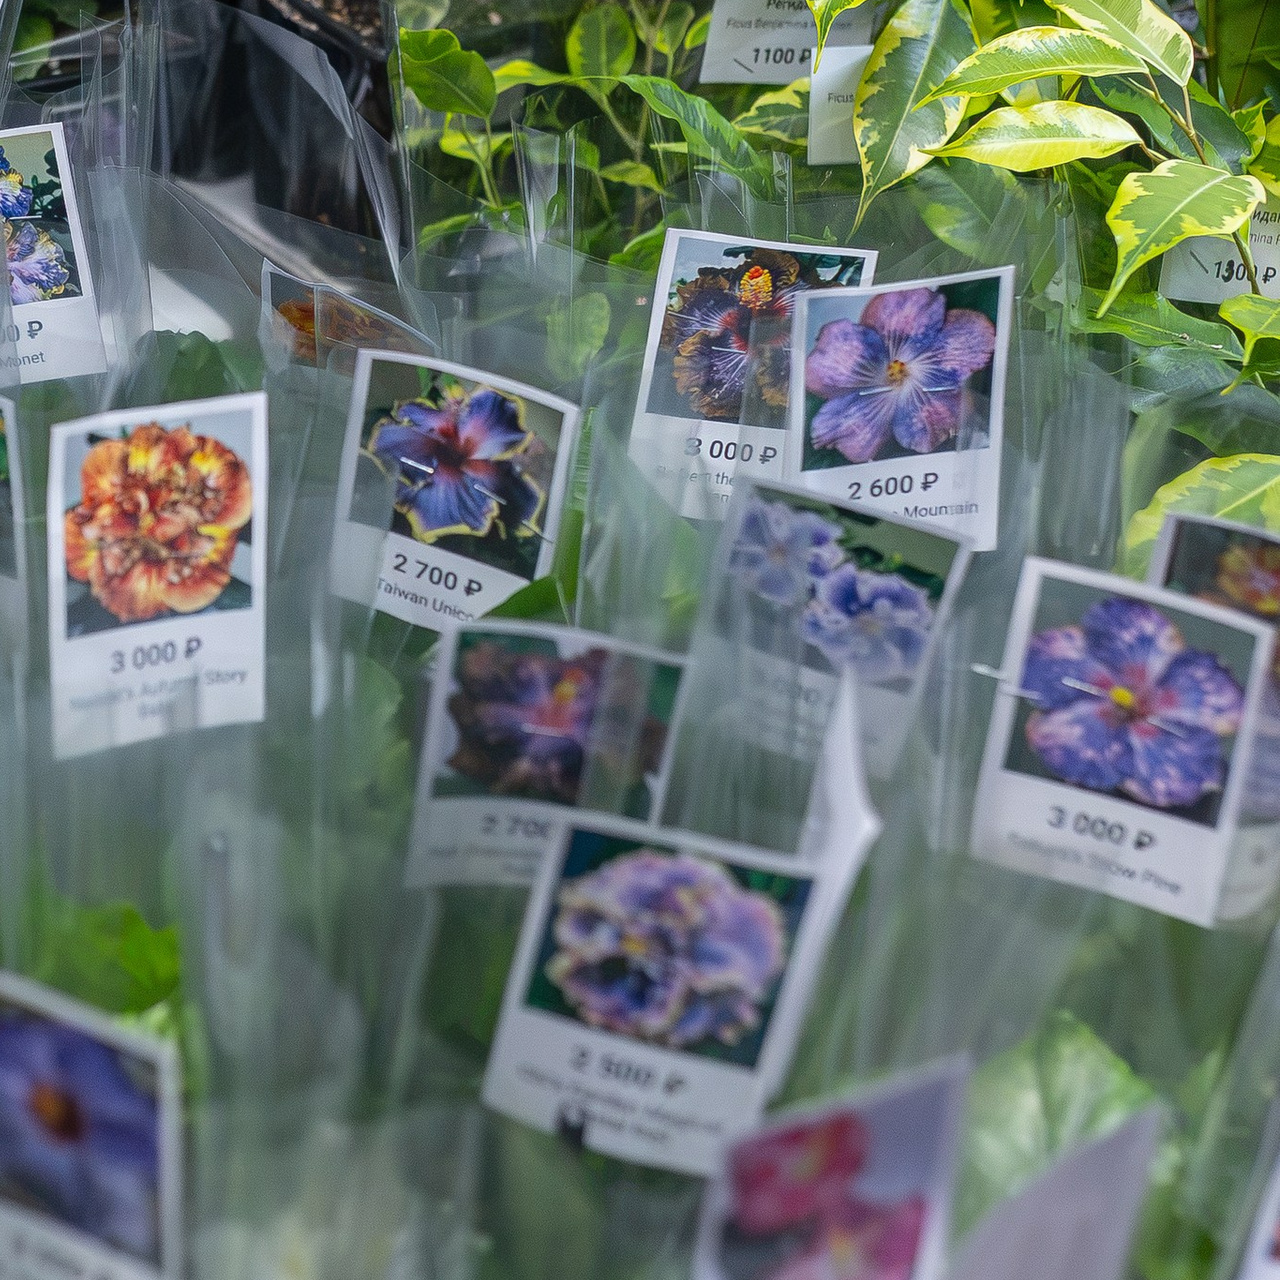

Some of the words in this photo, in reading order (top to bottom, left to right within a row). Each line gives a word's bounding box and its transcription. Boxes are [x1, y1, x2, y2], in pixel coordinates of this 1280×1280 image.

[752, 47, 795, 65] 1100
[827, 92, 855, 104] Ficus
[1261, 266, 1277, 284] ₽
[27, 320, 44, 339] ₽
[0, 351, 46, 368] Monet
[683, 437, 702, 457] 3
[709, 439, 754, 462] 000
[759, 445, 777, 465] ₽
[847, 481, 862, 500] 2
[869, 474, 913, 498] 600
[920, 472, 939, 492] ₽
[393, 553, 408, 574] 2
[415, 559, 458, 591] 700
[463, 578, 483, 597] ₽
[377, 577, 428, 608] Taiwan
[110, 649, 126, 675] 3
[131, 639, 177, 671] 000
[1045, 804, 1068, 830] 3
